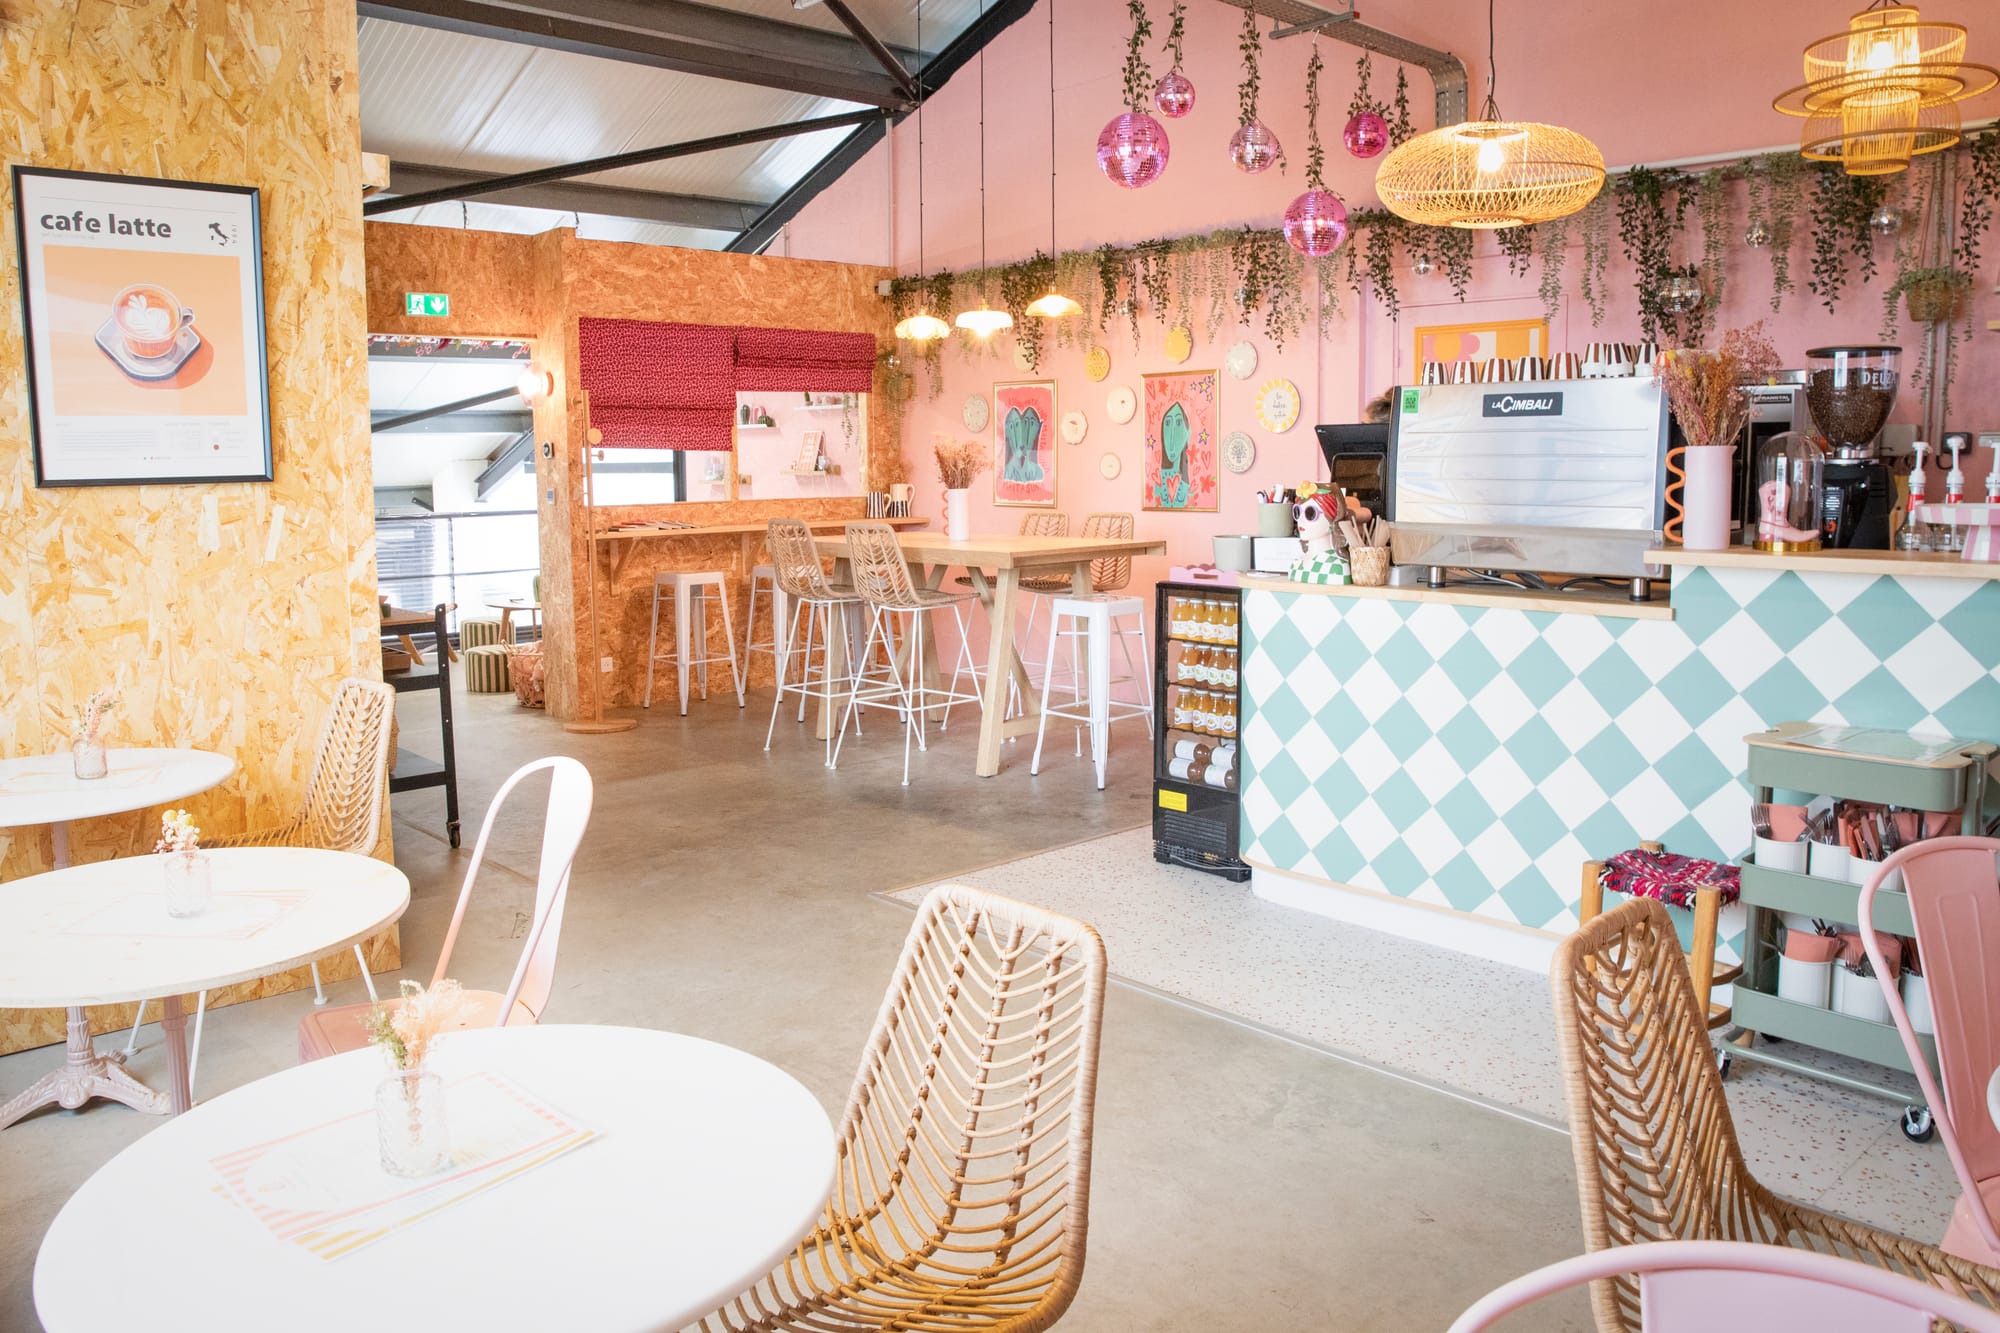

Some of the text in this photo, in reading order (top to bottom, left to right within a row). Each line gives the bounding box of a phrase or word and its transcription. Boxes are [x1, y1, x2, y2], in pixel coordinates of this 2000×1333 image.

[40, 210, 172, 238] cafe latte
[1501, 396, 1553, 413] CIMBALI
